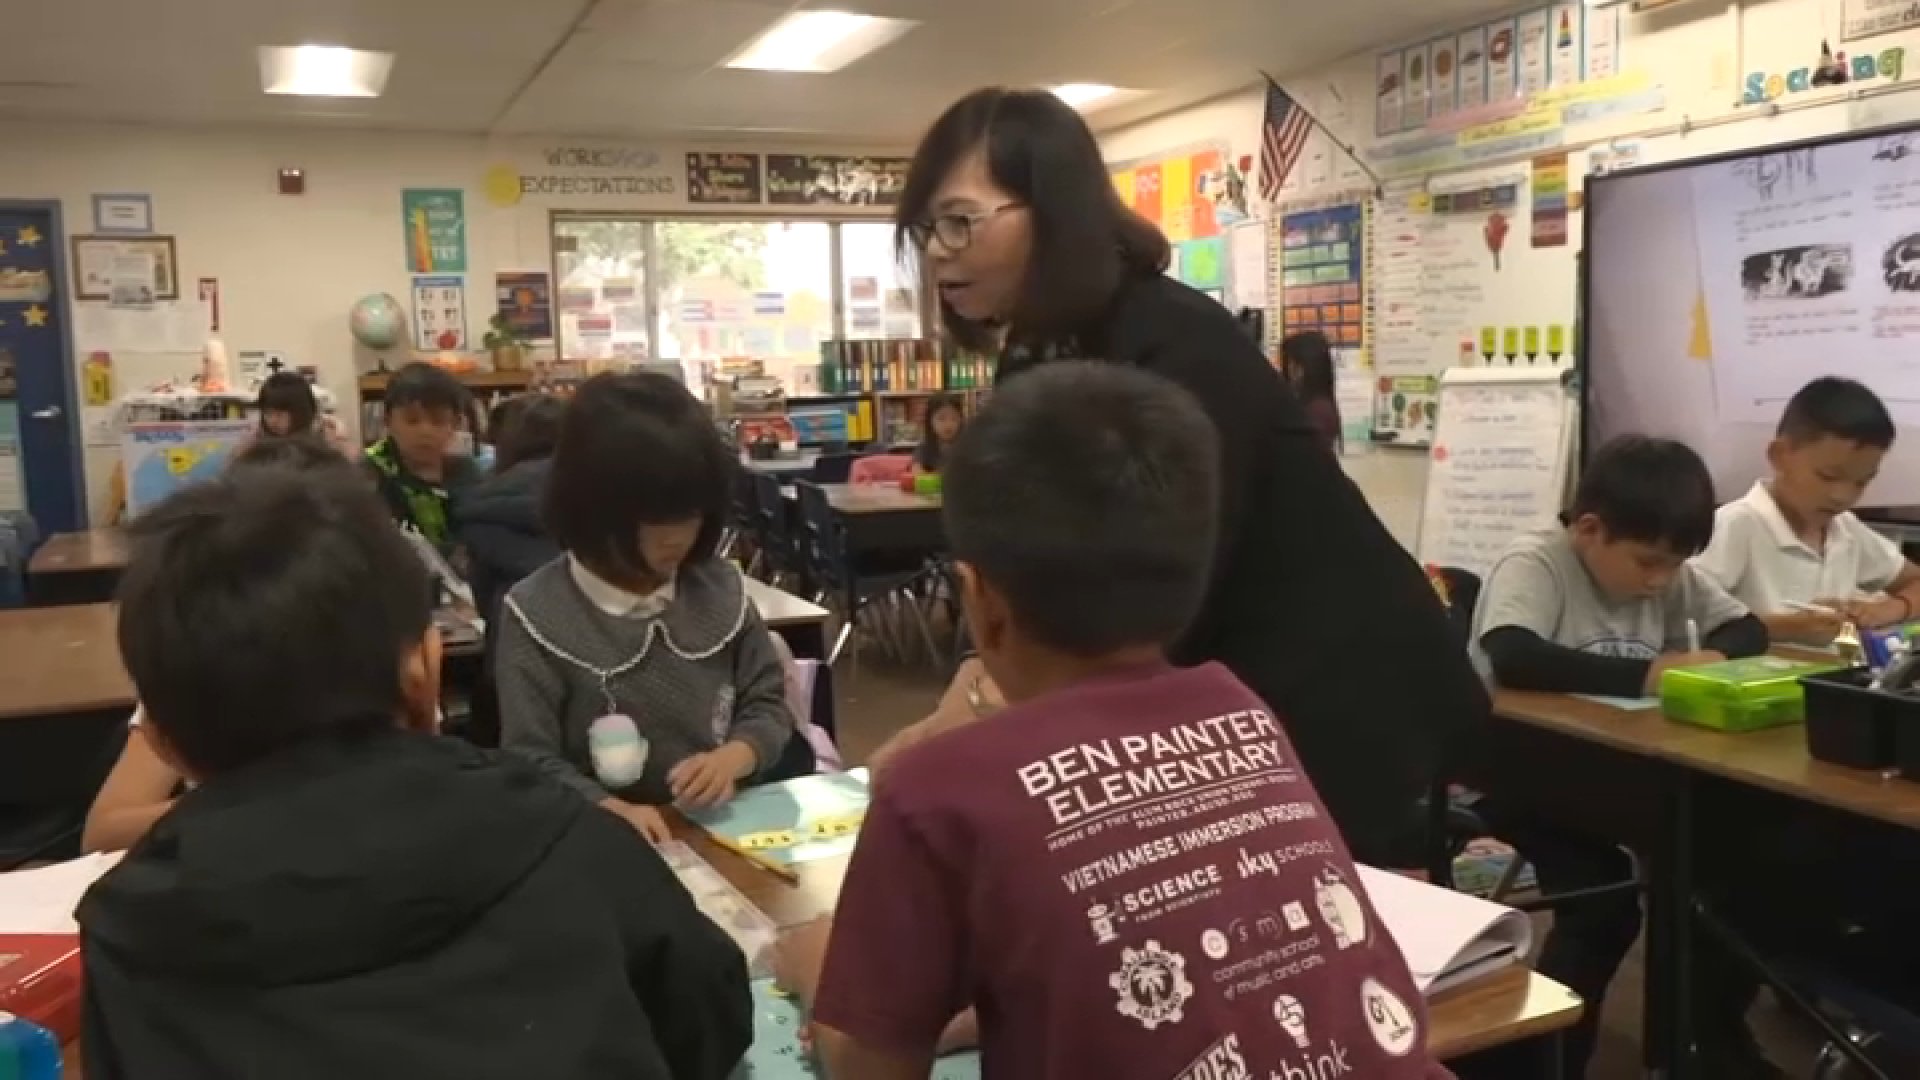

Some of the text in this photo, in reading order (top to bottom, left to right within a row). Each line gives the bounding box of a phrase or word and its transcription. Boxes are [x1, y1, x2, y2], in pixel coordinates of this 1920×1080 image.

[519, 175, 675, 194] EXPECTATIONS
[1017, 709, 1280, 797] BEN PAINTER
[1046, 739, 1283, 825] ELEMENTARY
[1061, 836, 1180, 894] VIETNAMESE
[1176, 810, 1268, 851] IMMERSION
[1122, 864, 1222, 912] SCIENCE
[1213, 948, 1281, 982] community
[1272, 961, 1301, 981] and
